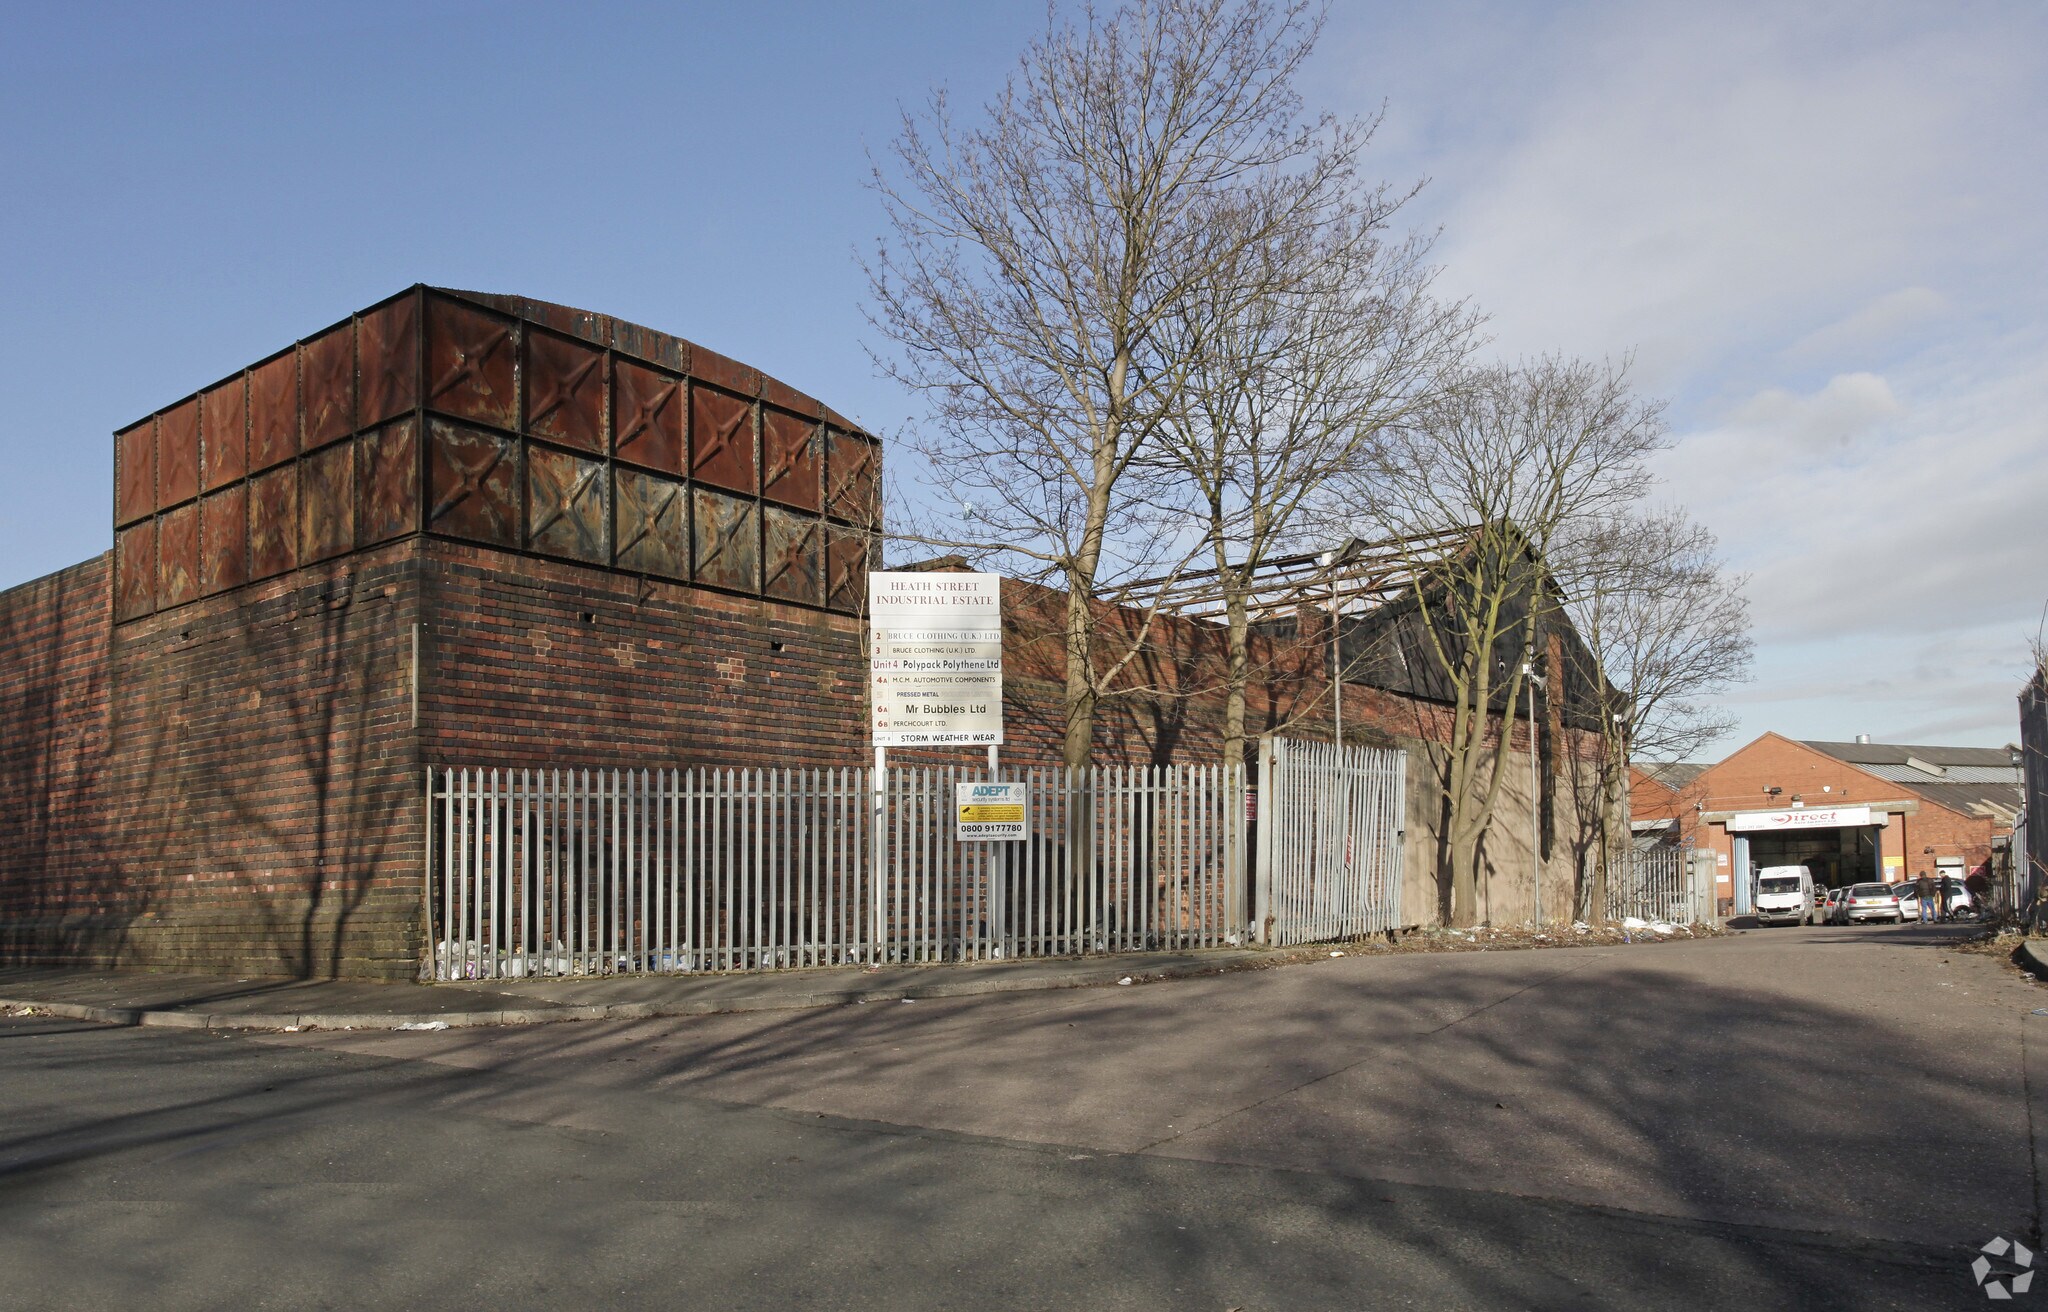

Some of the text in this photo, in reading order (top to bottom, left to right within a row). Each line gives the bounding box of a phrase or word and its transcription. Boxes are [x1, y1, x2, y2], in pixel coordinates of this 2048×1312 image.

[891, 582, 979, 591] HEATH STREET
[876, 596, 993, 604] INDUSTRIAL ESTATE
[916, 632, 958, 640] CLOTHING
[873, 660, 999, 671] Unit 4 Polypack Polythene Ltd
[877, 705, 986, 713] 6A Mr Bubbles Ltd
[877, 720, 889, 728] 6B
[900, 734, 929, 742] STORM
[932, 734, 969, 742] WEATHER
[972, 733, 996, 741] WEAR
[972, 786, 1010, 796] ADEPT
[985, 824, 1022, 832] 9177780
